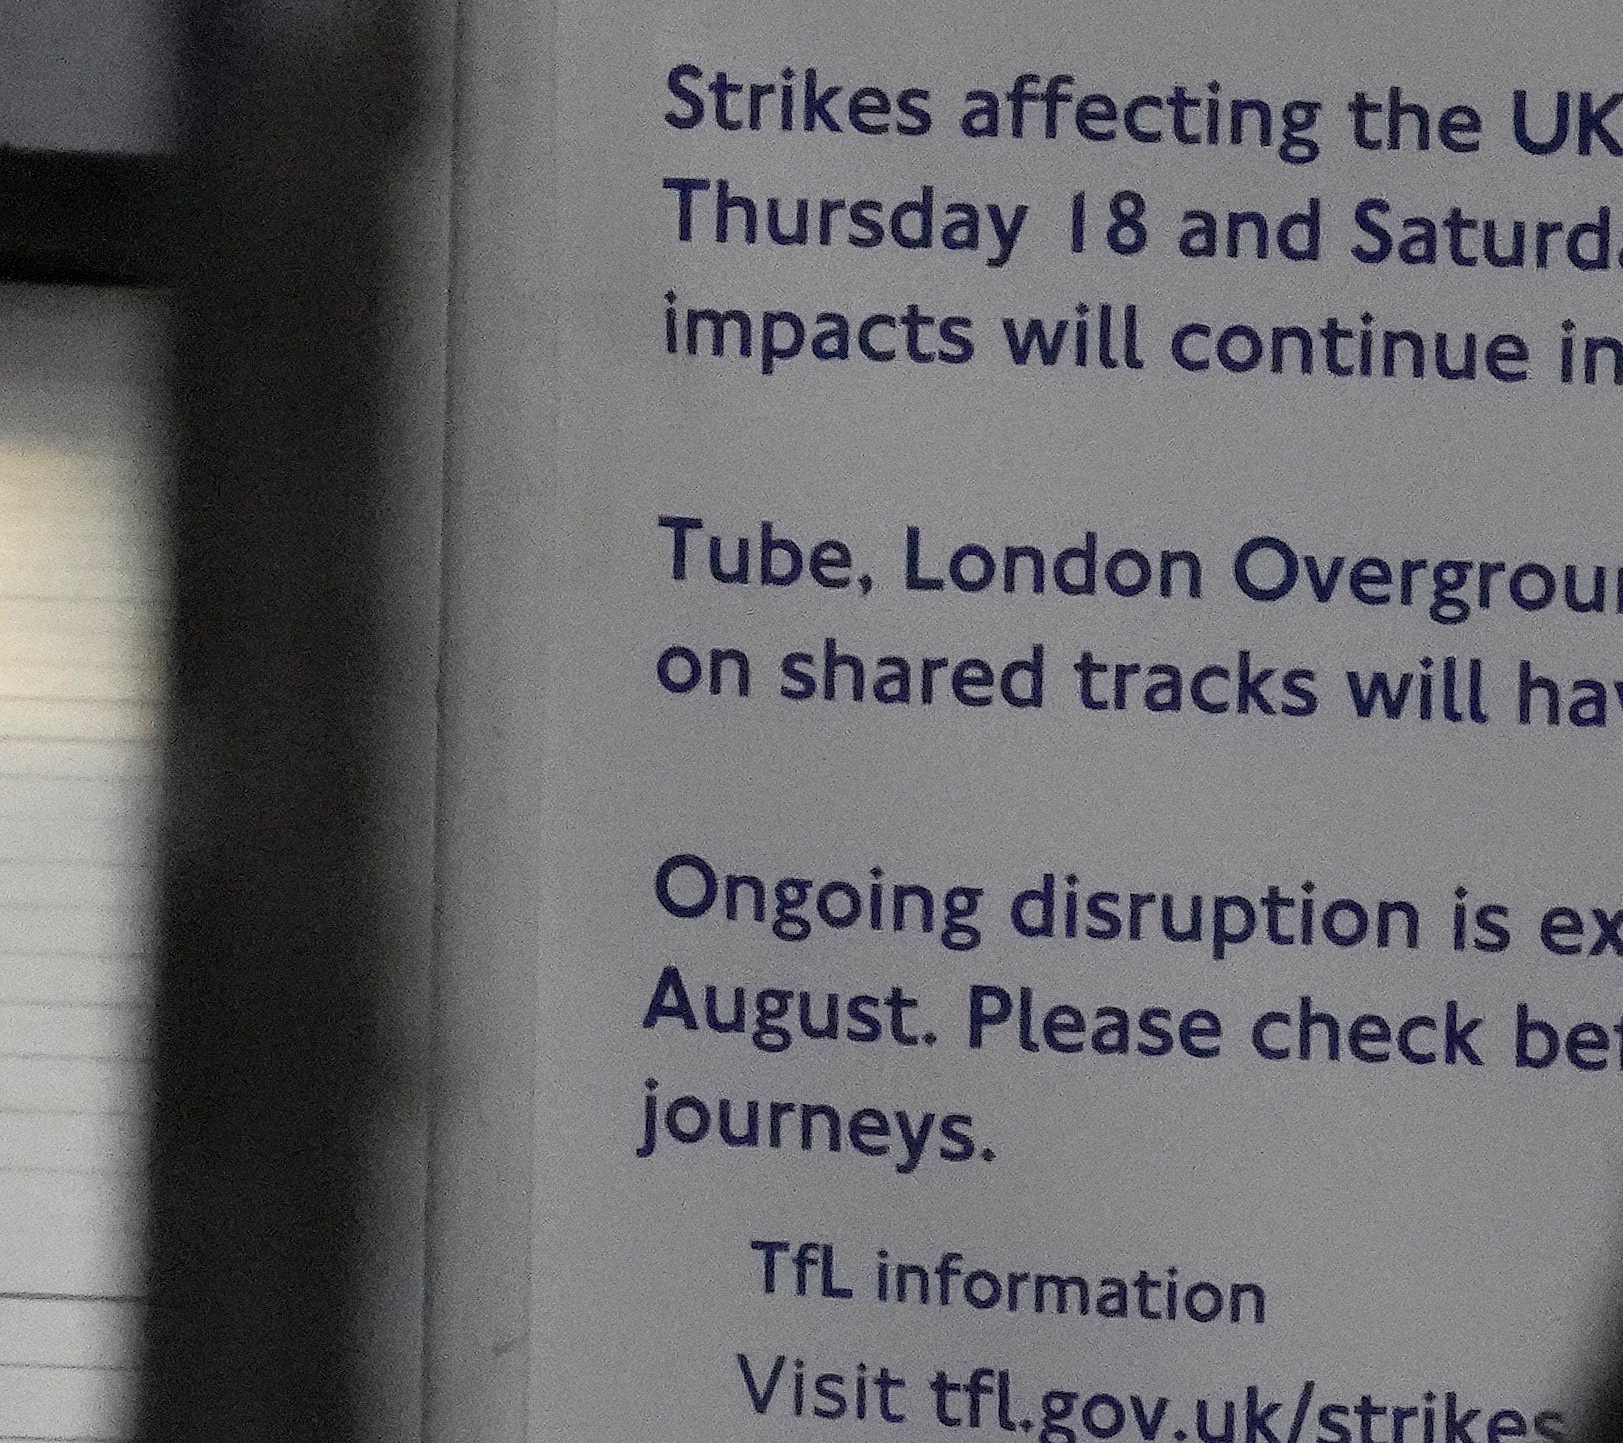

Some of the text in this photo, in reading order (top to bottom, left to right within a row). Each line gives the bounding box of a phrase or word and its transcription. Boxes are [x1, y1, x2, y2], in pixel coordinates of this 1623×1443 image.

[664, 63, 933, 137] Strikes
[960, 73, 1322, 166] affecting
[1347, 86, 1482, 154] the
[662, 177, 1028, 268] Thursday
[1071, 190, 1148, 256] 18
[1178, 197, 1321, 262] and
[665, 291, 975, 376] impacts
[1002, 303, 1144, 370] will
[1171, 312, 1529, 383] continue
[657, 515, 873, 595] Tube,
[905, 526, 1202, 599] London
[656, 645, 751, 697] on
[780, 637, 1045, 709] shared
[1073, 649, 1318, 717] tracks
[1346, 656, 1488, 724] will
[654, 853, 984, 952] Ongoing
[1010, 873, 1420, 961] disruption
[1453, 886, 1511, 953] is
[642, 965, 937, 1053] August.
[968, 984, 1222, 1059] Please
[1251, 995, 1483, 1066] check
[635, 1078, 995, 1175] journeys.
[750, 1239, 1266, 1324] TfL information
[737, 1353, 1566, 1443] Visit tfl.gov.uk/strikes
